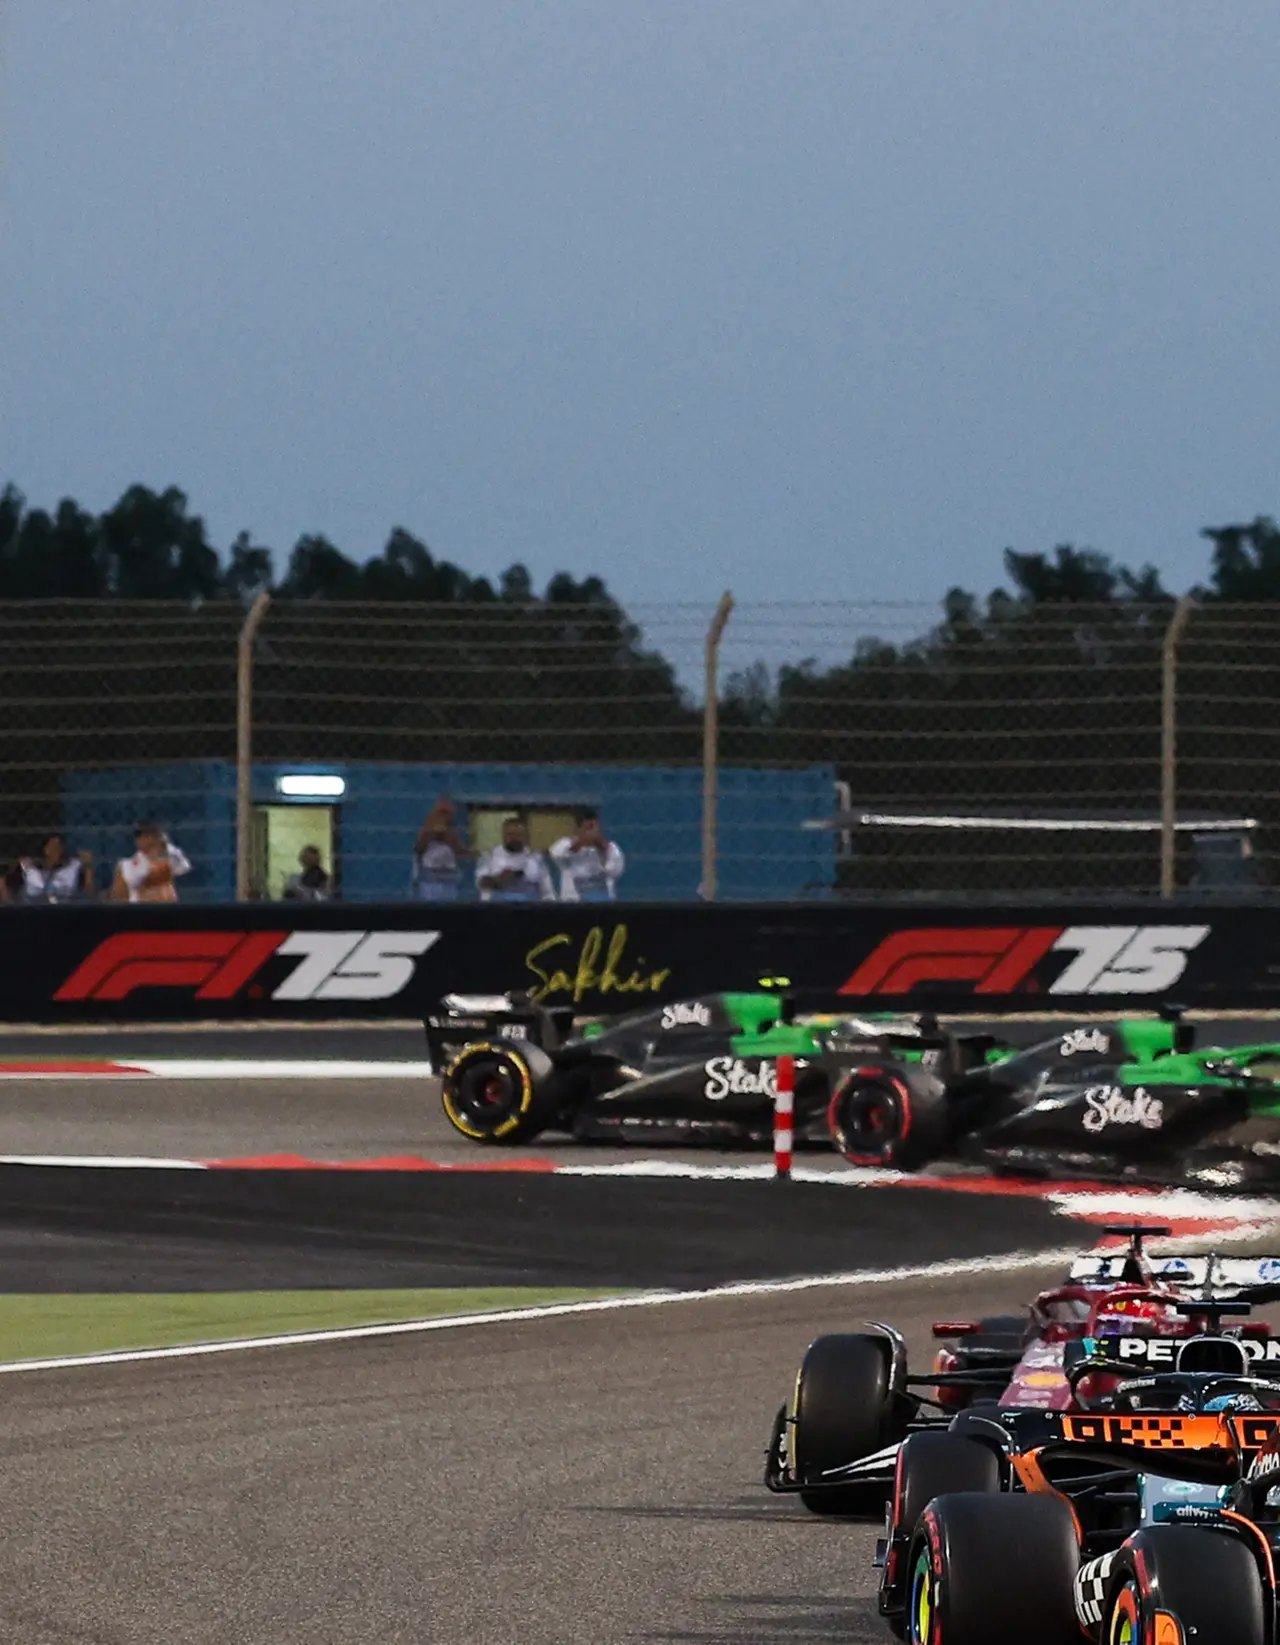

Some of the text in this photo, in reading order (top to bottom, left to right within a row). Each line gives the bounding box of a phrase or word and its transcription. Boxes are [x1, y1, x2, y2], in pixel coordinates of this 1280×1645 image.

[53, 931, 441, 999] F1 75
[525, 924, 669, 1001] Sakhir
[837, 926, 1211, 995] F1 75
[1082, 1084, 1163, 1133] Stake
